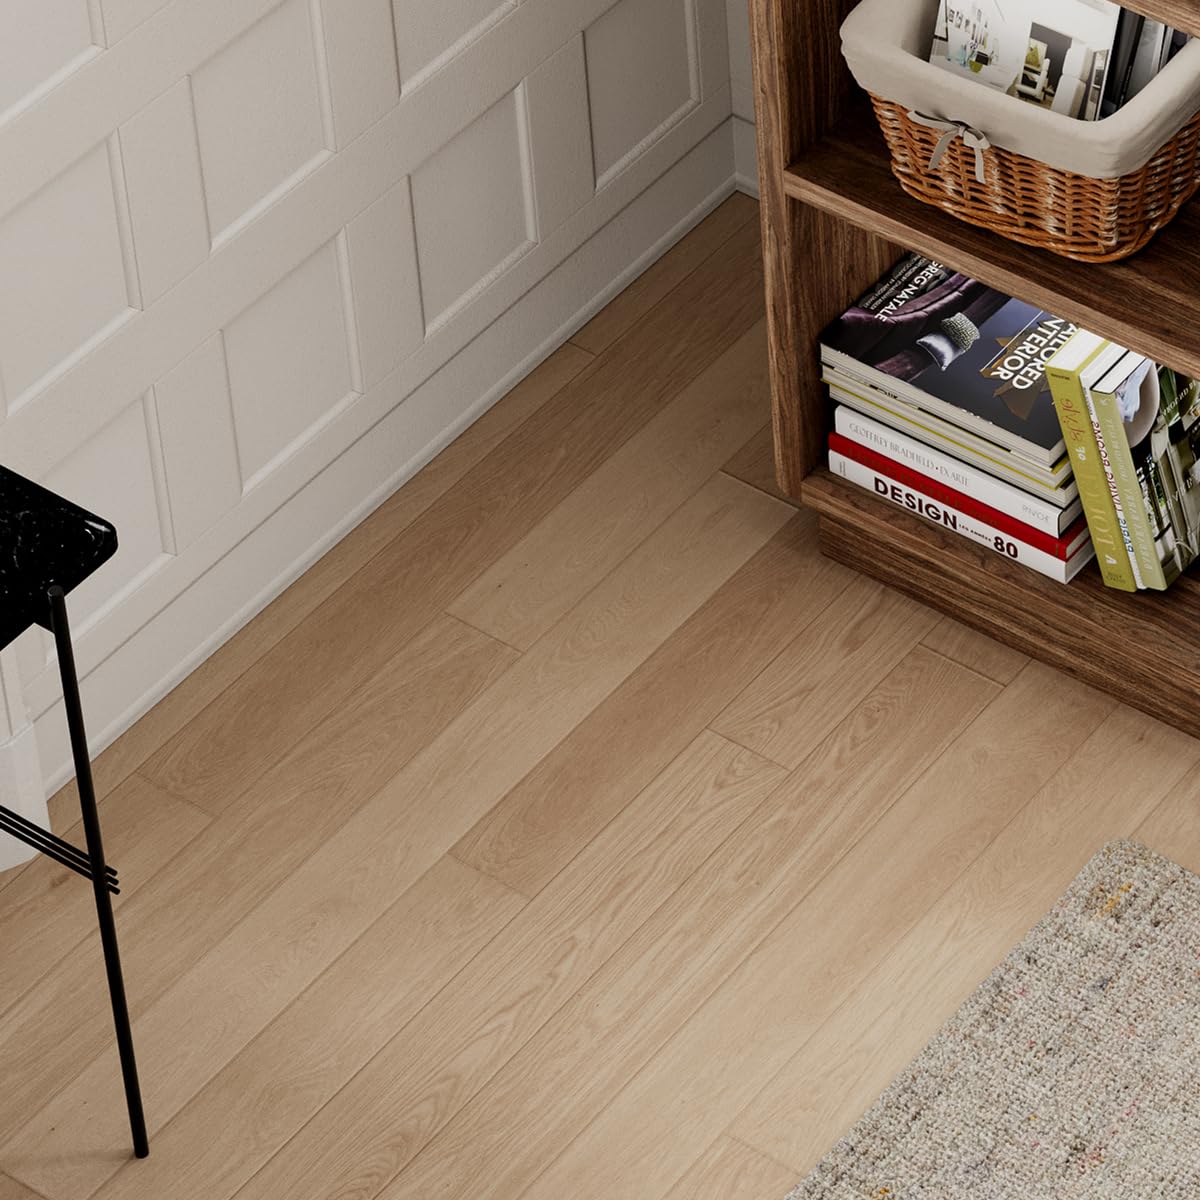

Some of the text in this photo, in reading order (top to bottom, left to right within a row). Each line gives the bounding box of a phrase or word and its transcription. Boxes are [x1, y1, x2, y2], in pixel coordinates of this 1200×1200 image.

[874, 284, 919, 322] NATALE
[990, 315, 1065, 380] NTERIOR
[1012, 323, 1077, 389] AILORED
[849, 423, 888, 449] GEOFFREY
[889, 440, 935, 470] BRADFIELD
[873, 477, 958, 531] DESIGN
[993, 535, 1019, 560] 80
